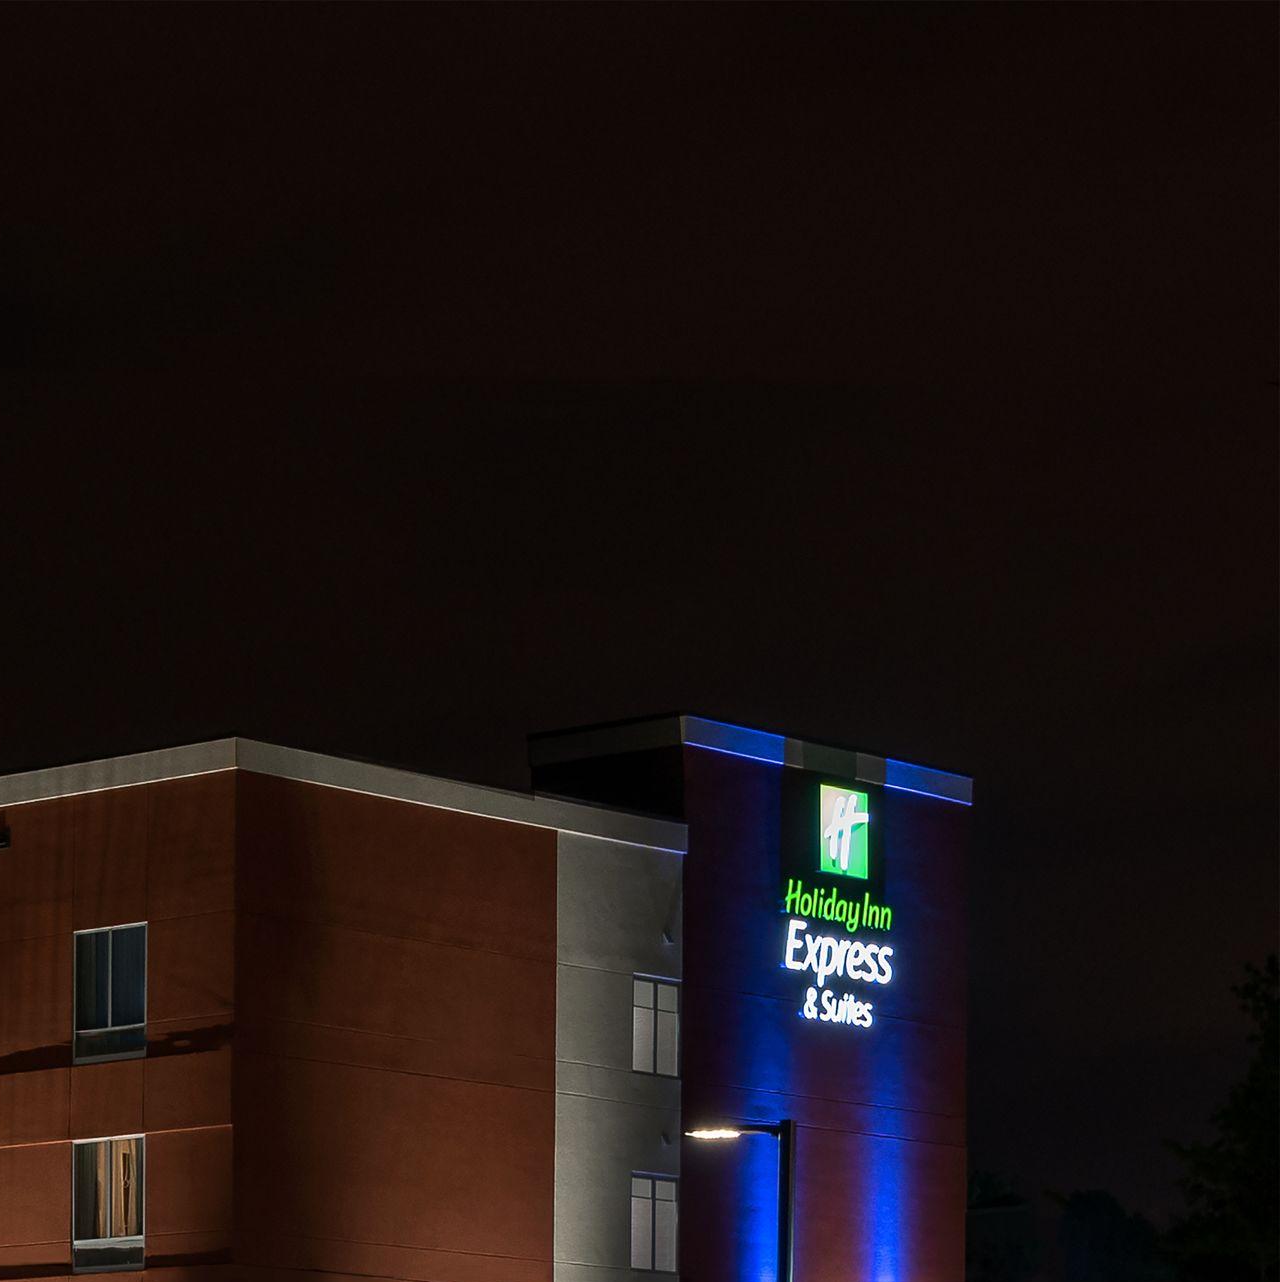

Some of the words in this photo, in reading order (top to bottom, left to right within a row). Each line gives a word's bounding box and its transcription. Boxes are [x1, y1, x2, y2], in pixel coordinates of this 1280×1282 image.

[785, 879, 859, 933] Holiday
[864, 892, 892, 931] Inn
[785, 918, 894, 987] Express
[803, 986, 819, 1020] &
[820, 988, 873, 1028] Suites
